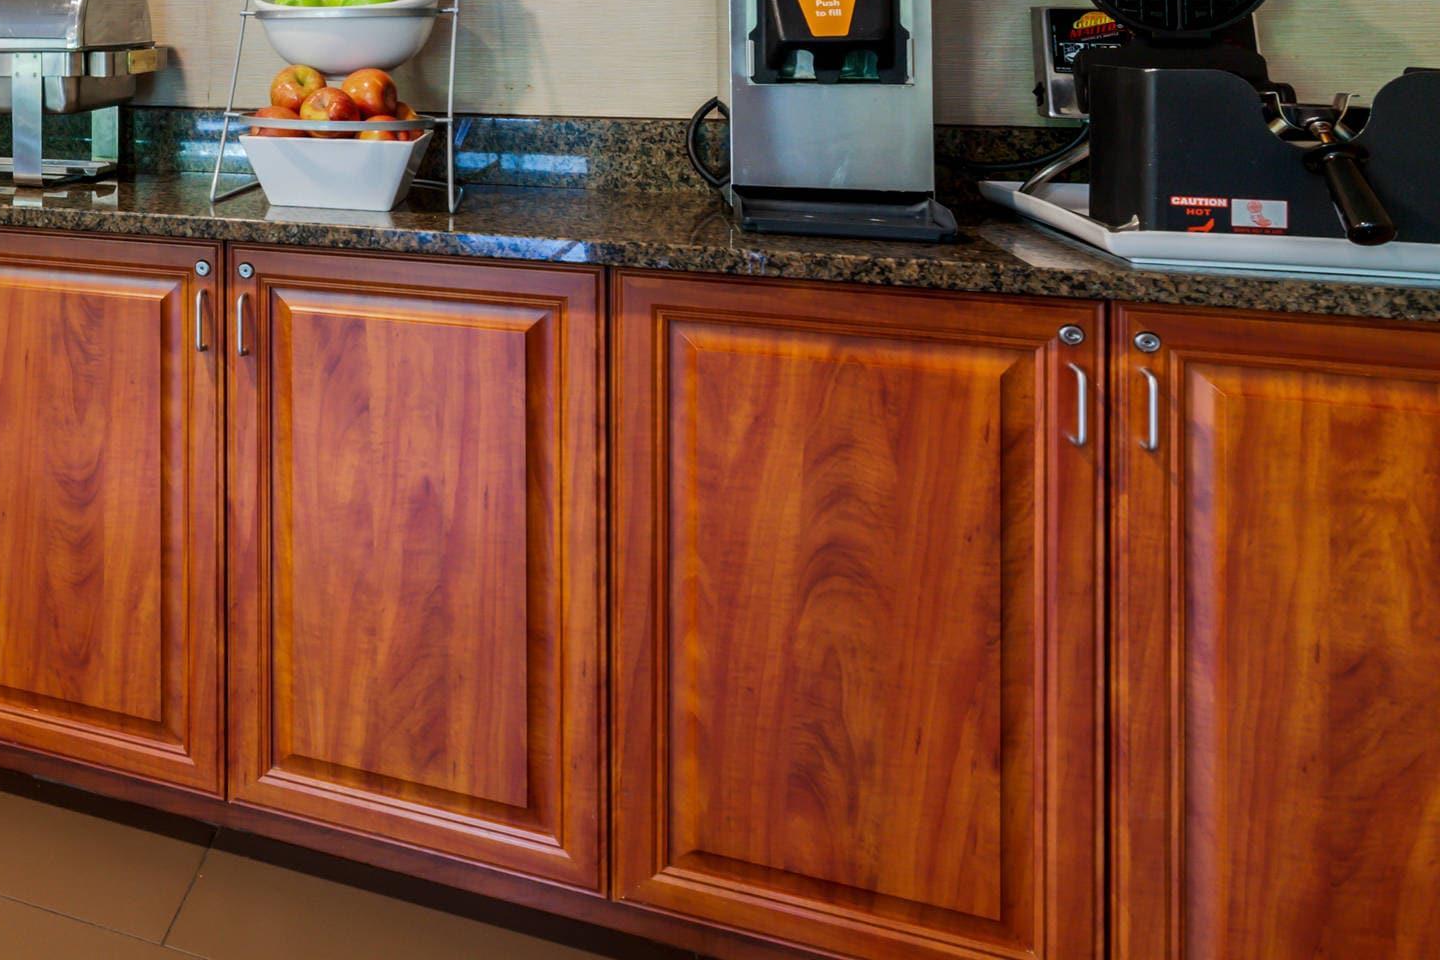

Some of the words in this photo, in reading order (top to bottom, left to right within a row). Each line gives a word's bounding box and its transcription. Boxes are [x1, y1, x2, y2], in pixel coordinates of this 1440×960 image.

[815, 0, 840, 7] Push
[815, 9, 827, 17] to
[828, 8, 842, 17] fill
[1170, 196, 1228, 208] CAUTION
[1186, 208, 1212, 216] HOT
